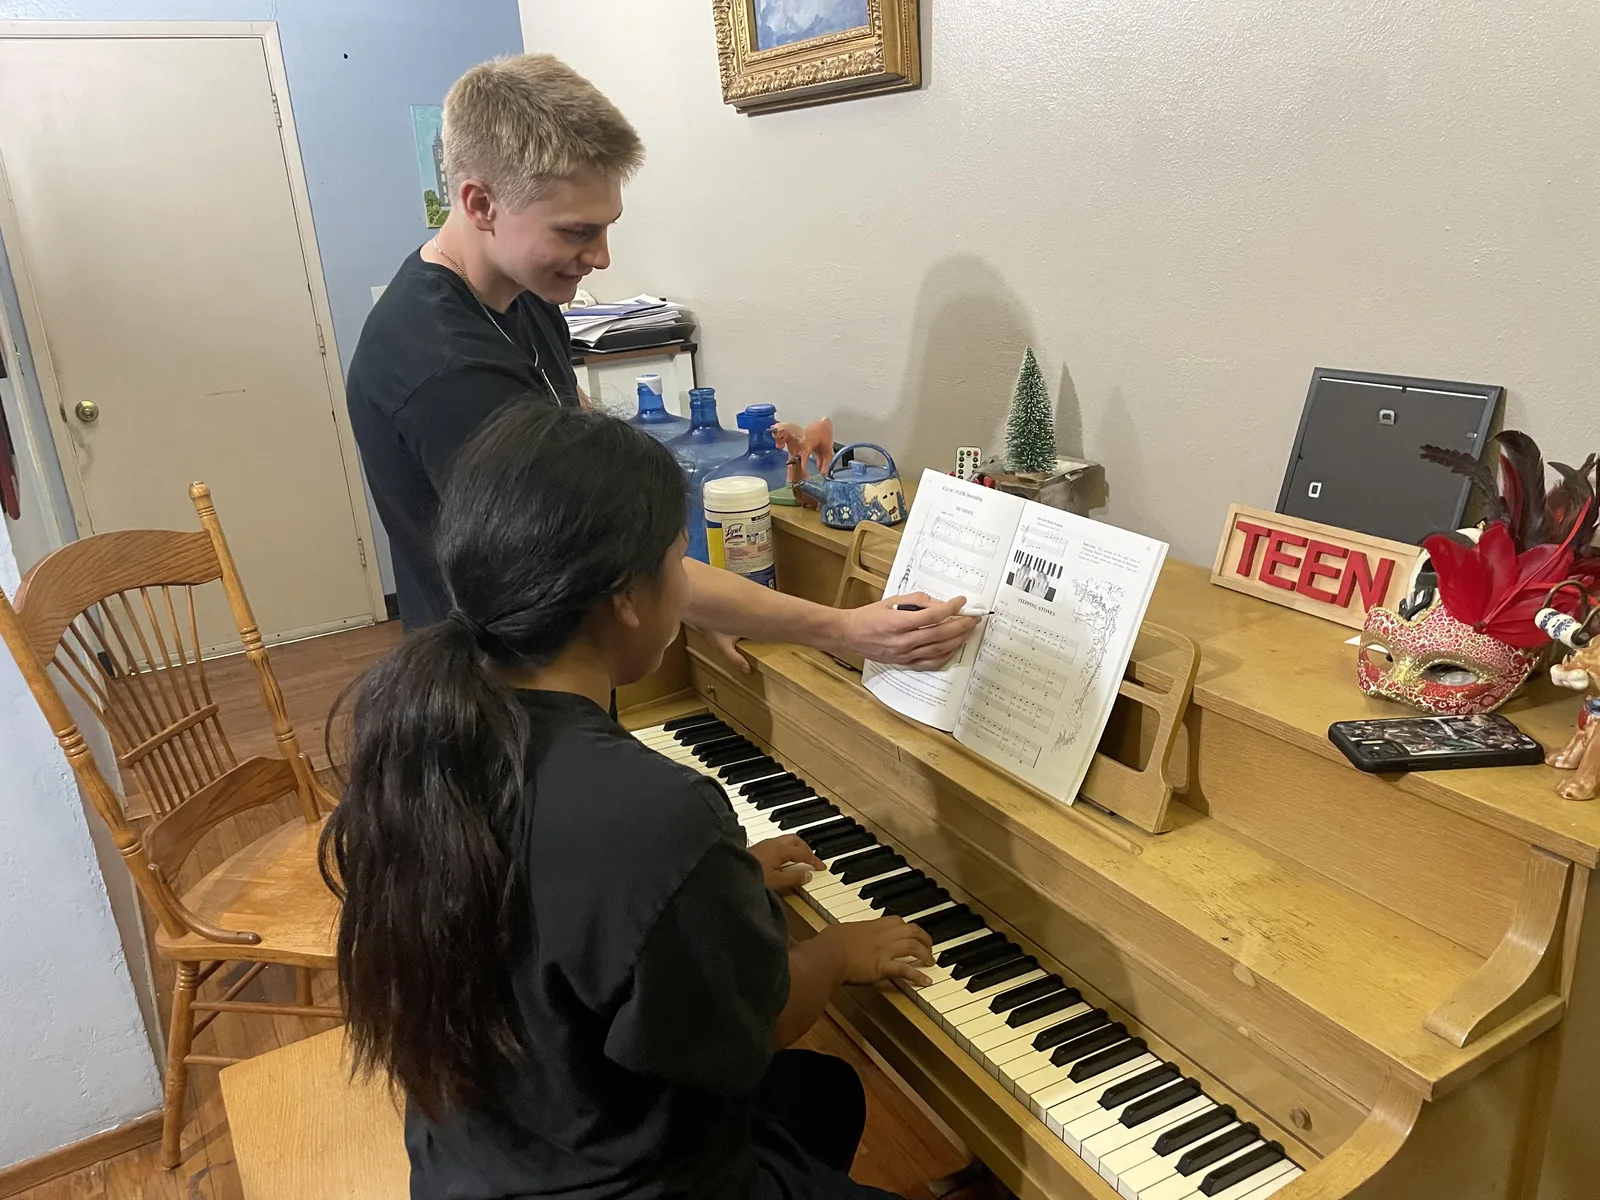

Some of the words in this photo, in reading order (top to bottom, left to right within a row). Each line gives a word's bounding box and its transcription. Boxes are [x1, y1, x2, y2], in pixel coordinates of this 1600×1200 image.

[725, 524, 743, 538] Lysol
[1235, 520, 1395, 614] TEEN
[1018, 598, 1038, 610] STEPPING
[1038, 605, 1056, 616] STONES
